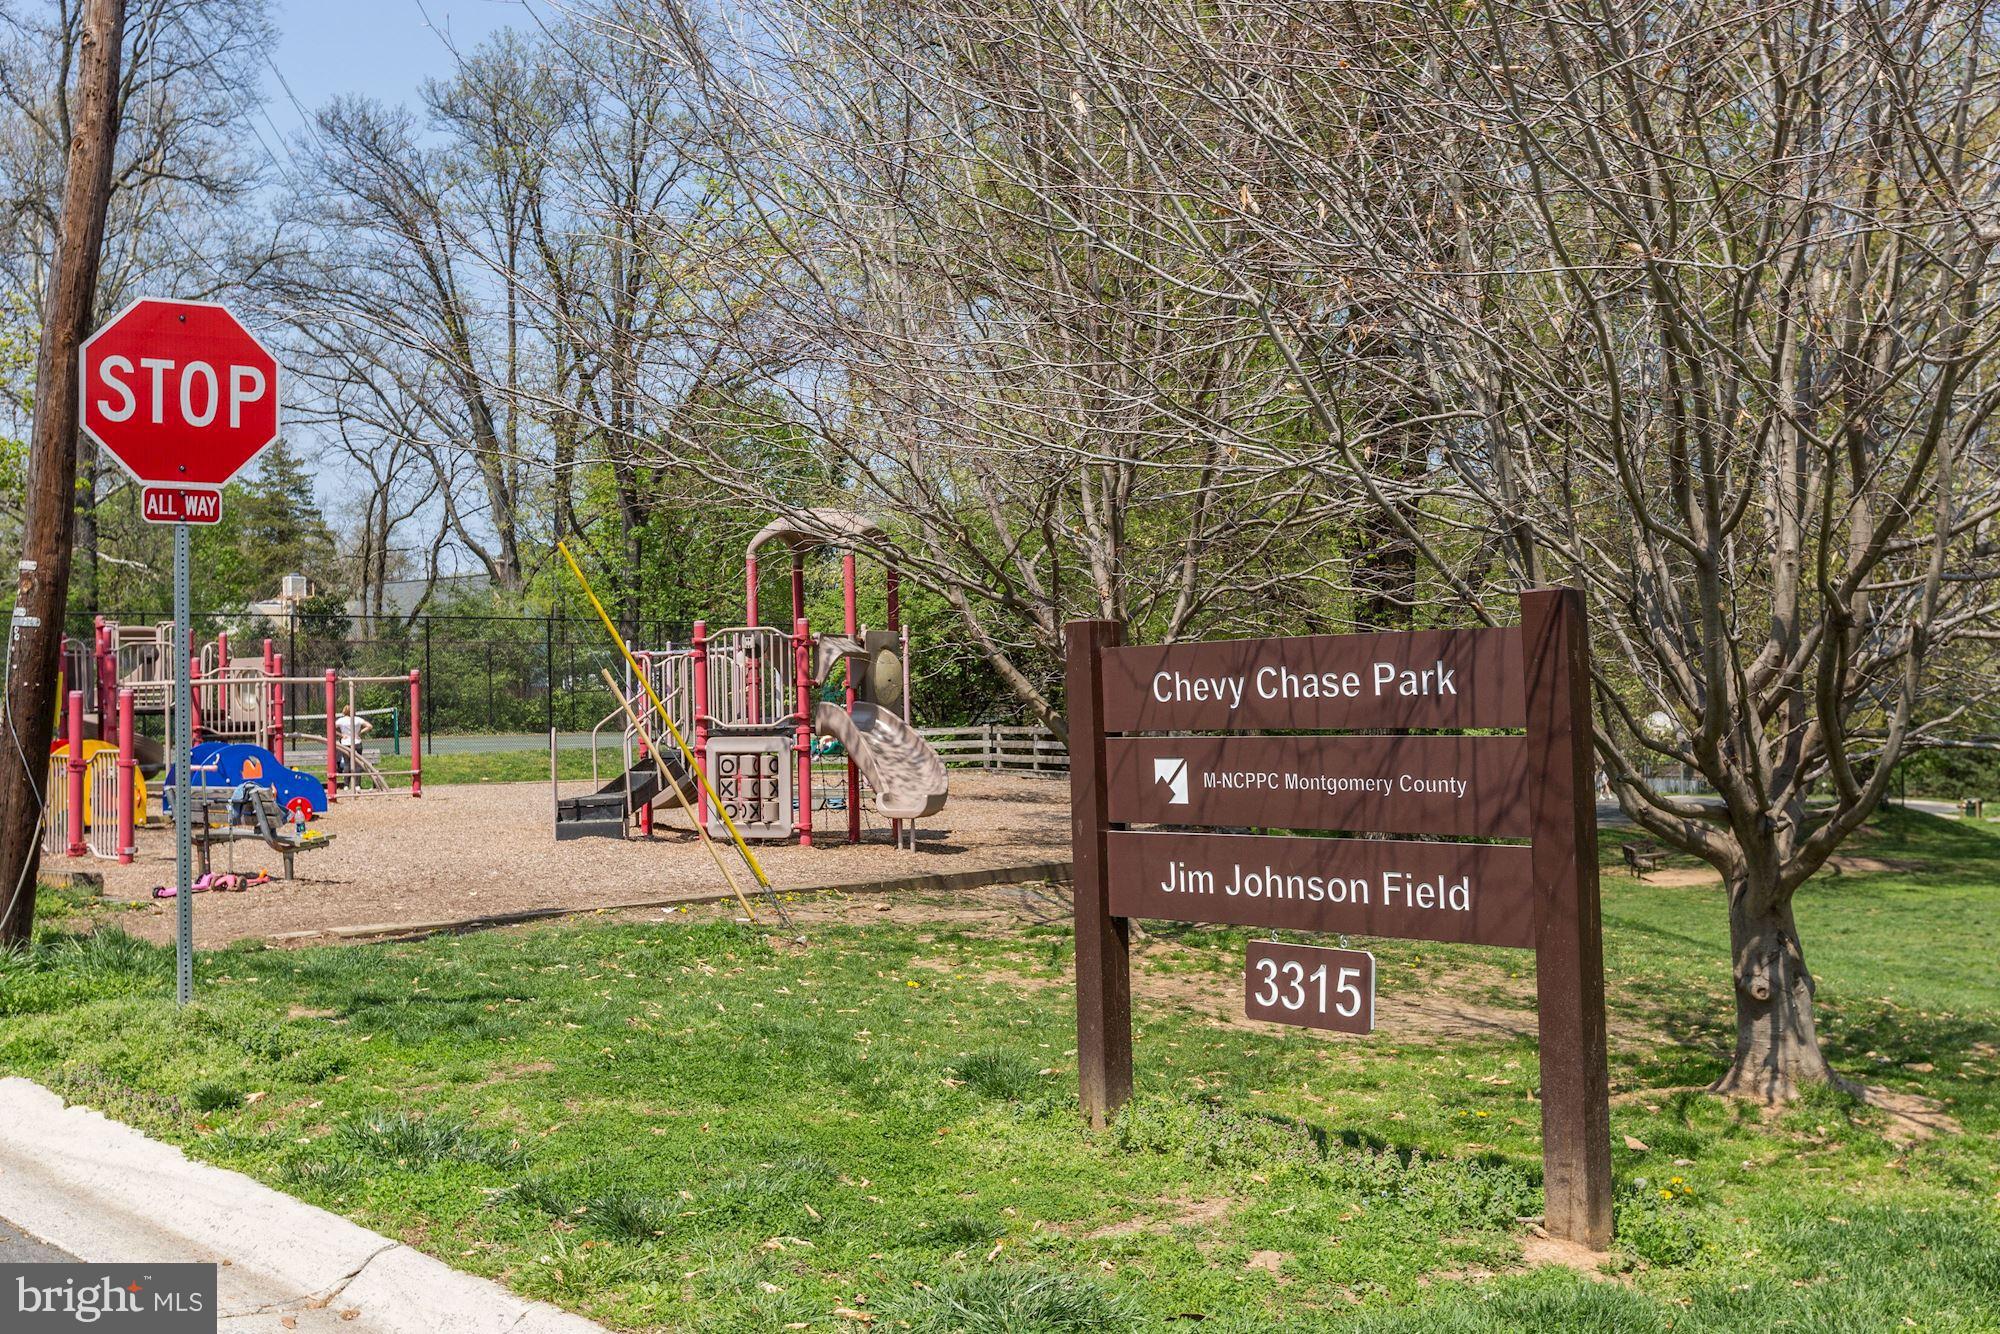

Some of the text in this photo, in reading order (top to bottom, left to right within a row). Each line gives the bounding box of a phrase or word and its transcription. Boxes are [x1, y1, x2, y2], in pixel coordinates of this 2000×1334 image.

[97, 355, 266, 428] STOP
[147, 493, 217, 517] ALL WAY
[1152, 660, 1457, 709] Chevy Chase Park
[1203, 771, 1467, 798] M-NCPPC Montgomery County
[1161, 861, 1470, 911] Jim Johnson Field
[1254, 957, 1362, 1017] 3315
